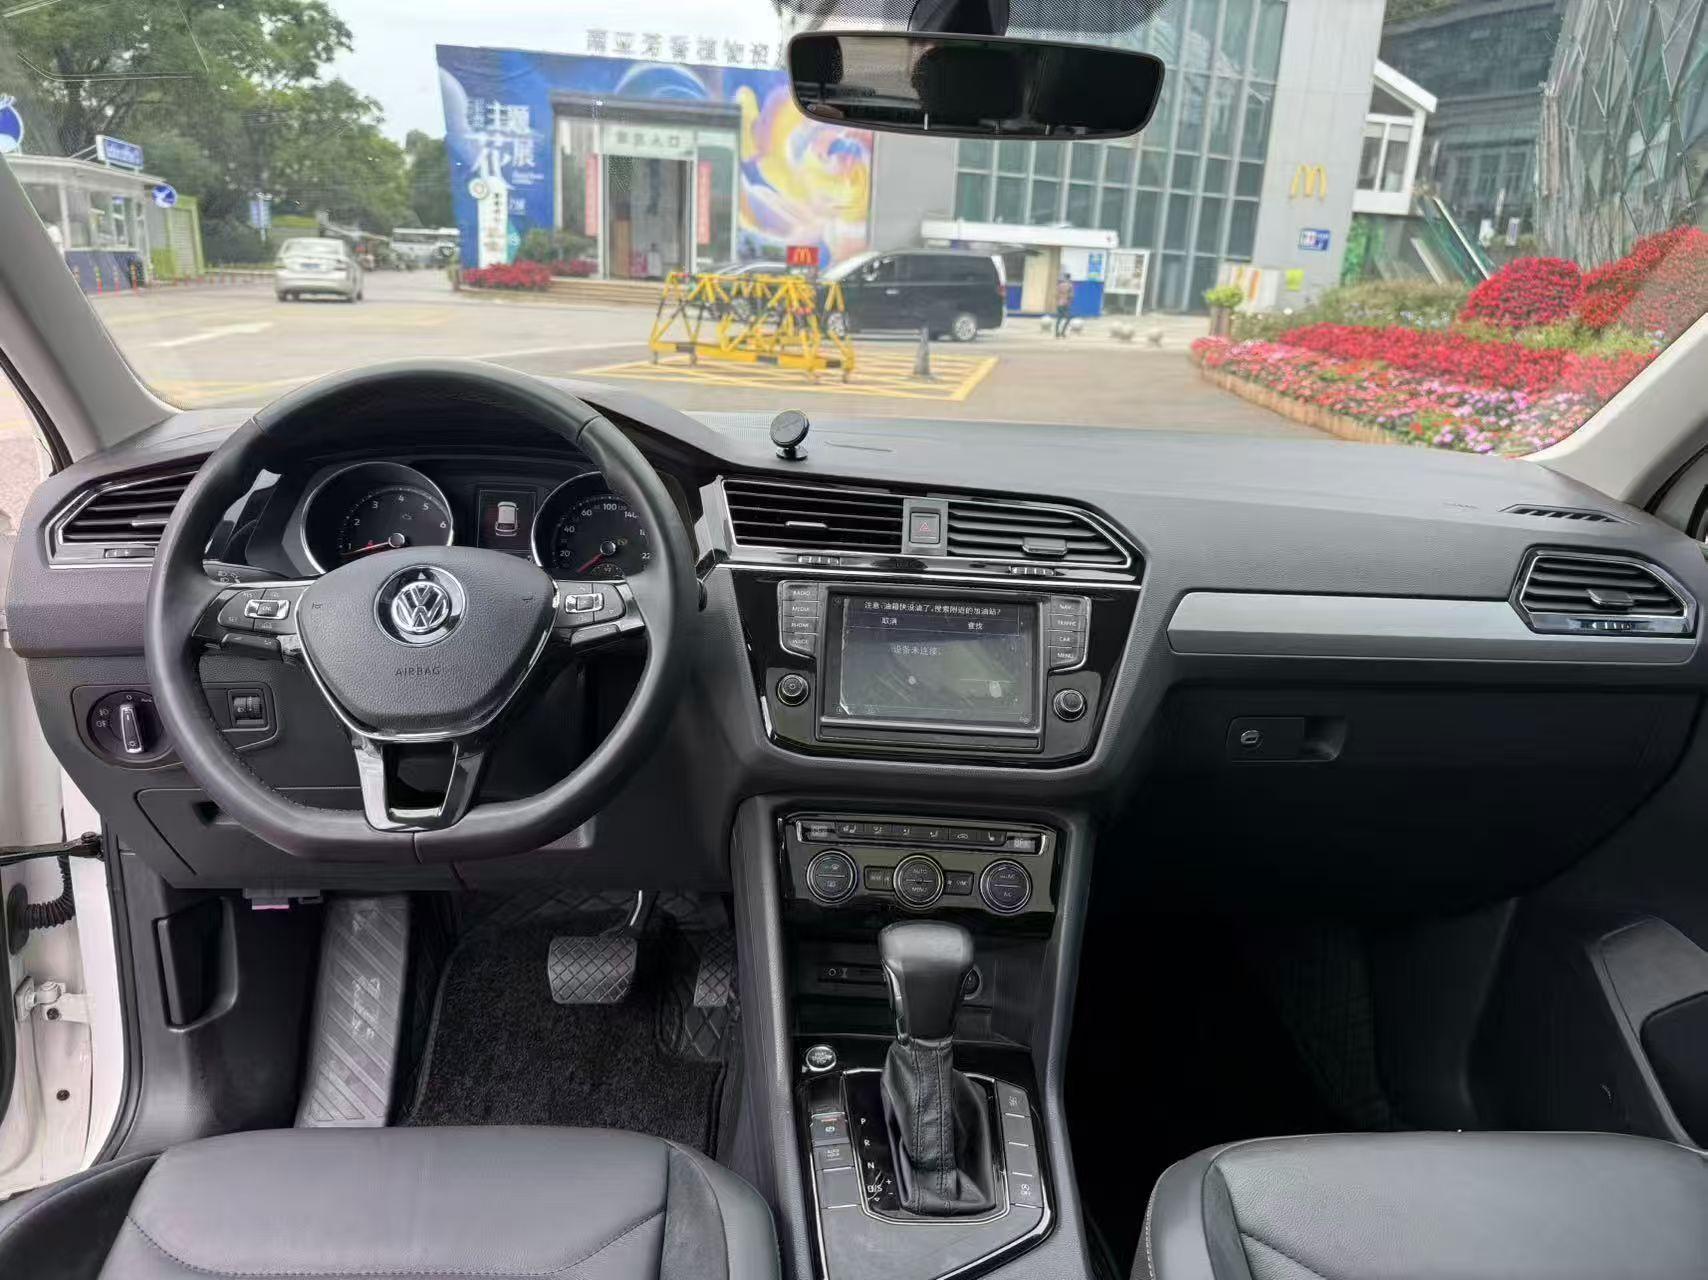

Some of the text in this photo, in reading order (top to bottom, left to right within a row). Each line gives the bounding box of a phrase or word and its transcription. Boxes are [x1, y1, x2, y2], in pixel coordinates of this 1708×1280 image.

[487, 100, 531, 134] 主题
[372, 501, 379, 509] 3
[423, 502, 429, 511] 5
[603, 503, 617, 511] 100
[354, 518, 360, 526] 2
[440, 520, 447, 529] 6
[563, 525, 575, 533] 40
[881, 617, 897, 625] 取消
[967, 621, 984, 630] 查找
[395, 666, 441, 677] AIRBAG
[861, 1117, 867, 1125] P
